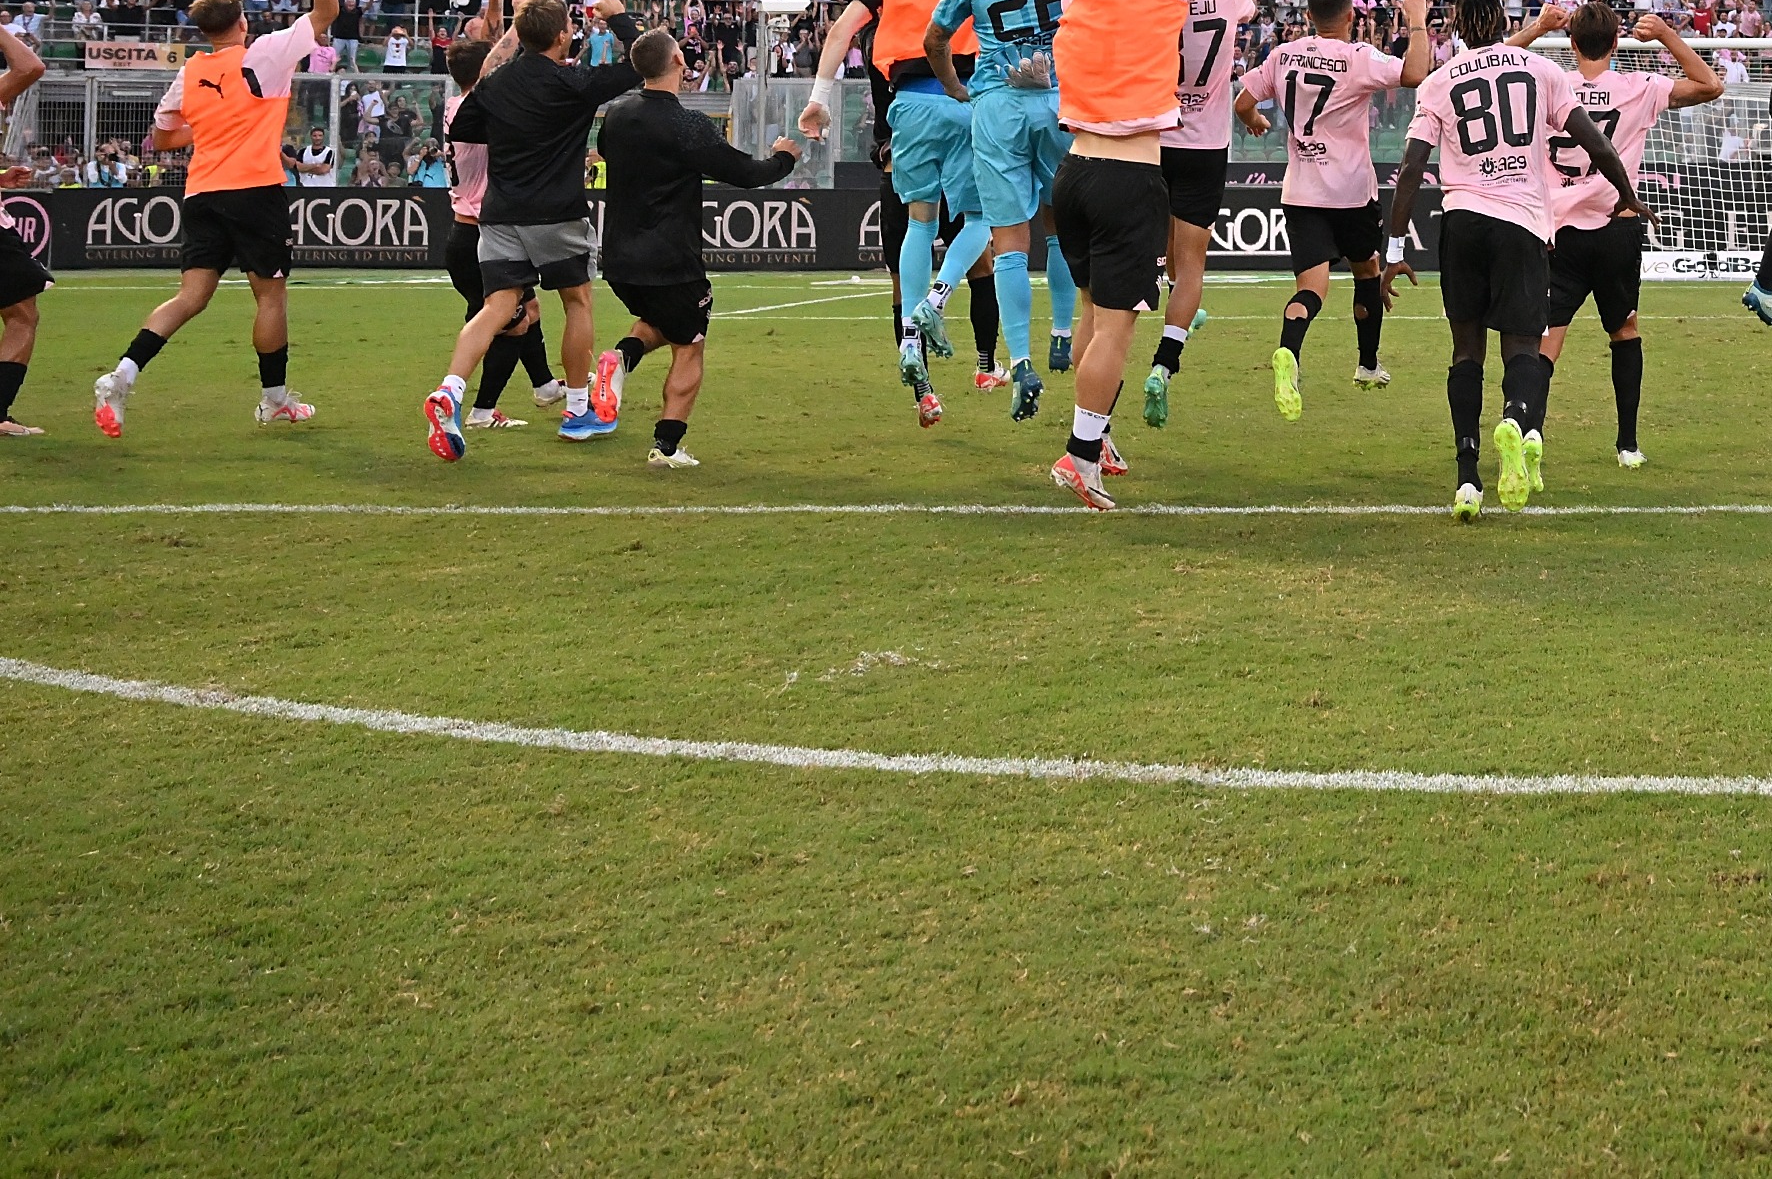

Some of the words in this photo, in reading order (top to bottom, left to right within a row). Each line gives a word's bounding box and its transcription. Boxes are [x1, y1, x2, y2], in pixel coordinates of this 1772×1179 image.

[88, 47, 158, 61] USCITA
[167, 52, 178, 63] 6
[1290, 54, 1348, 73] FRANCESCO
[1450, 55, 1529, 80] COULIBALY
[1284, 69, 1336, 137] 17
[1449, 71, 1537, 157] 80
[702, 197, 817, 248] GORÀ
[86, 249, 157, 261] CATERING
[161, 249, 181, 261] ED
[354, 250, 374, 262] ED
[379, 250, 429, 262] EVENTI
[743, 253, 761, 264] ED
[766, 253, 817, 264] EVENTI
